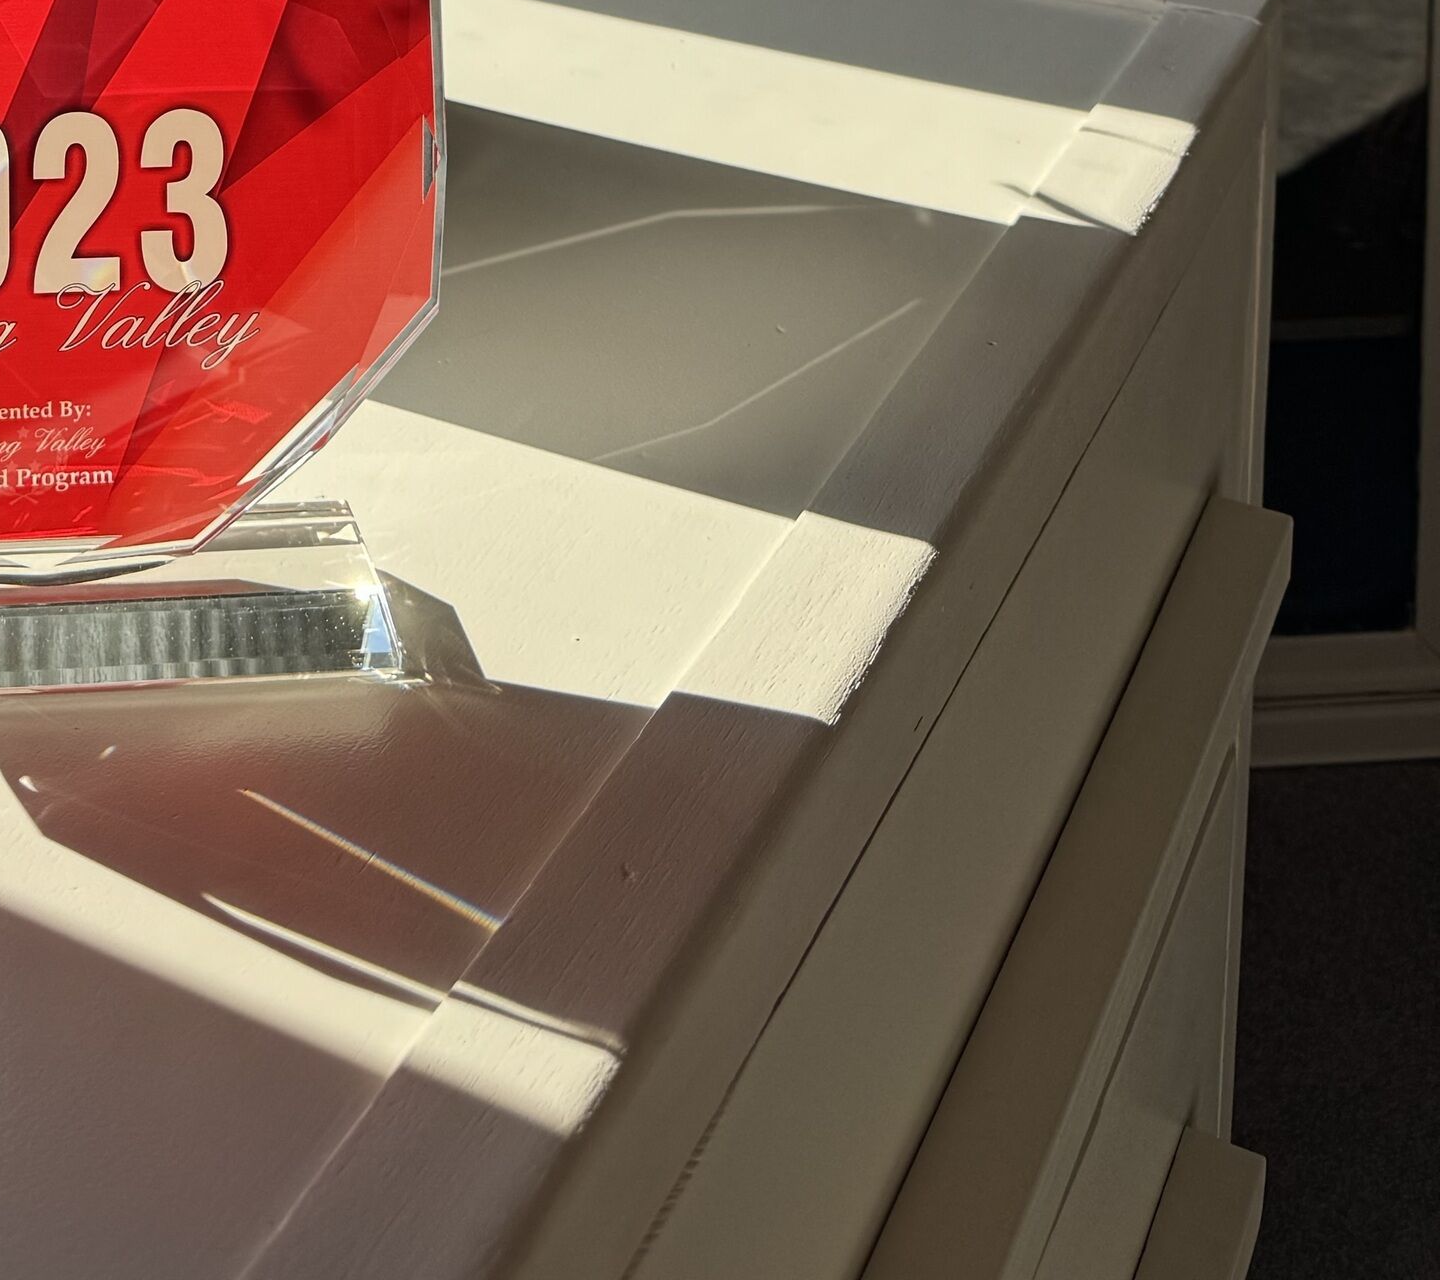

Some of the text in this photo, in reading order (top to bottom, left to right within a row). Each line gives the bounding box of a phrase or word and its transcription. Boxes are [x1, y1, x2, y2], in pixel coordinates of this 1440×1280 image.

[55, 279, 260, 371] Valley
[60, 402, 92, 422] By:
[33, 427, 107, 461] Valley
[15, 466, 114, 492] Program
